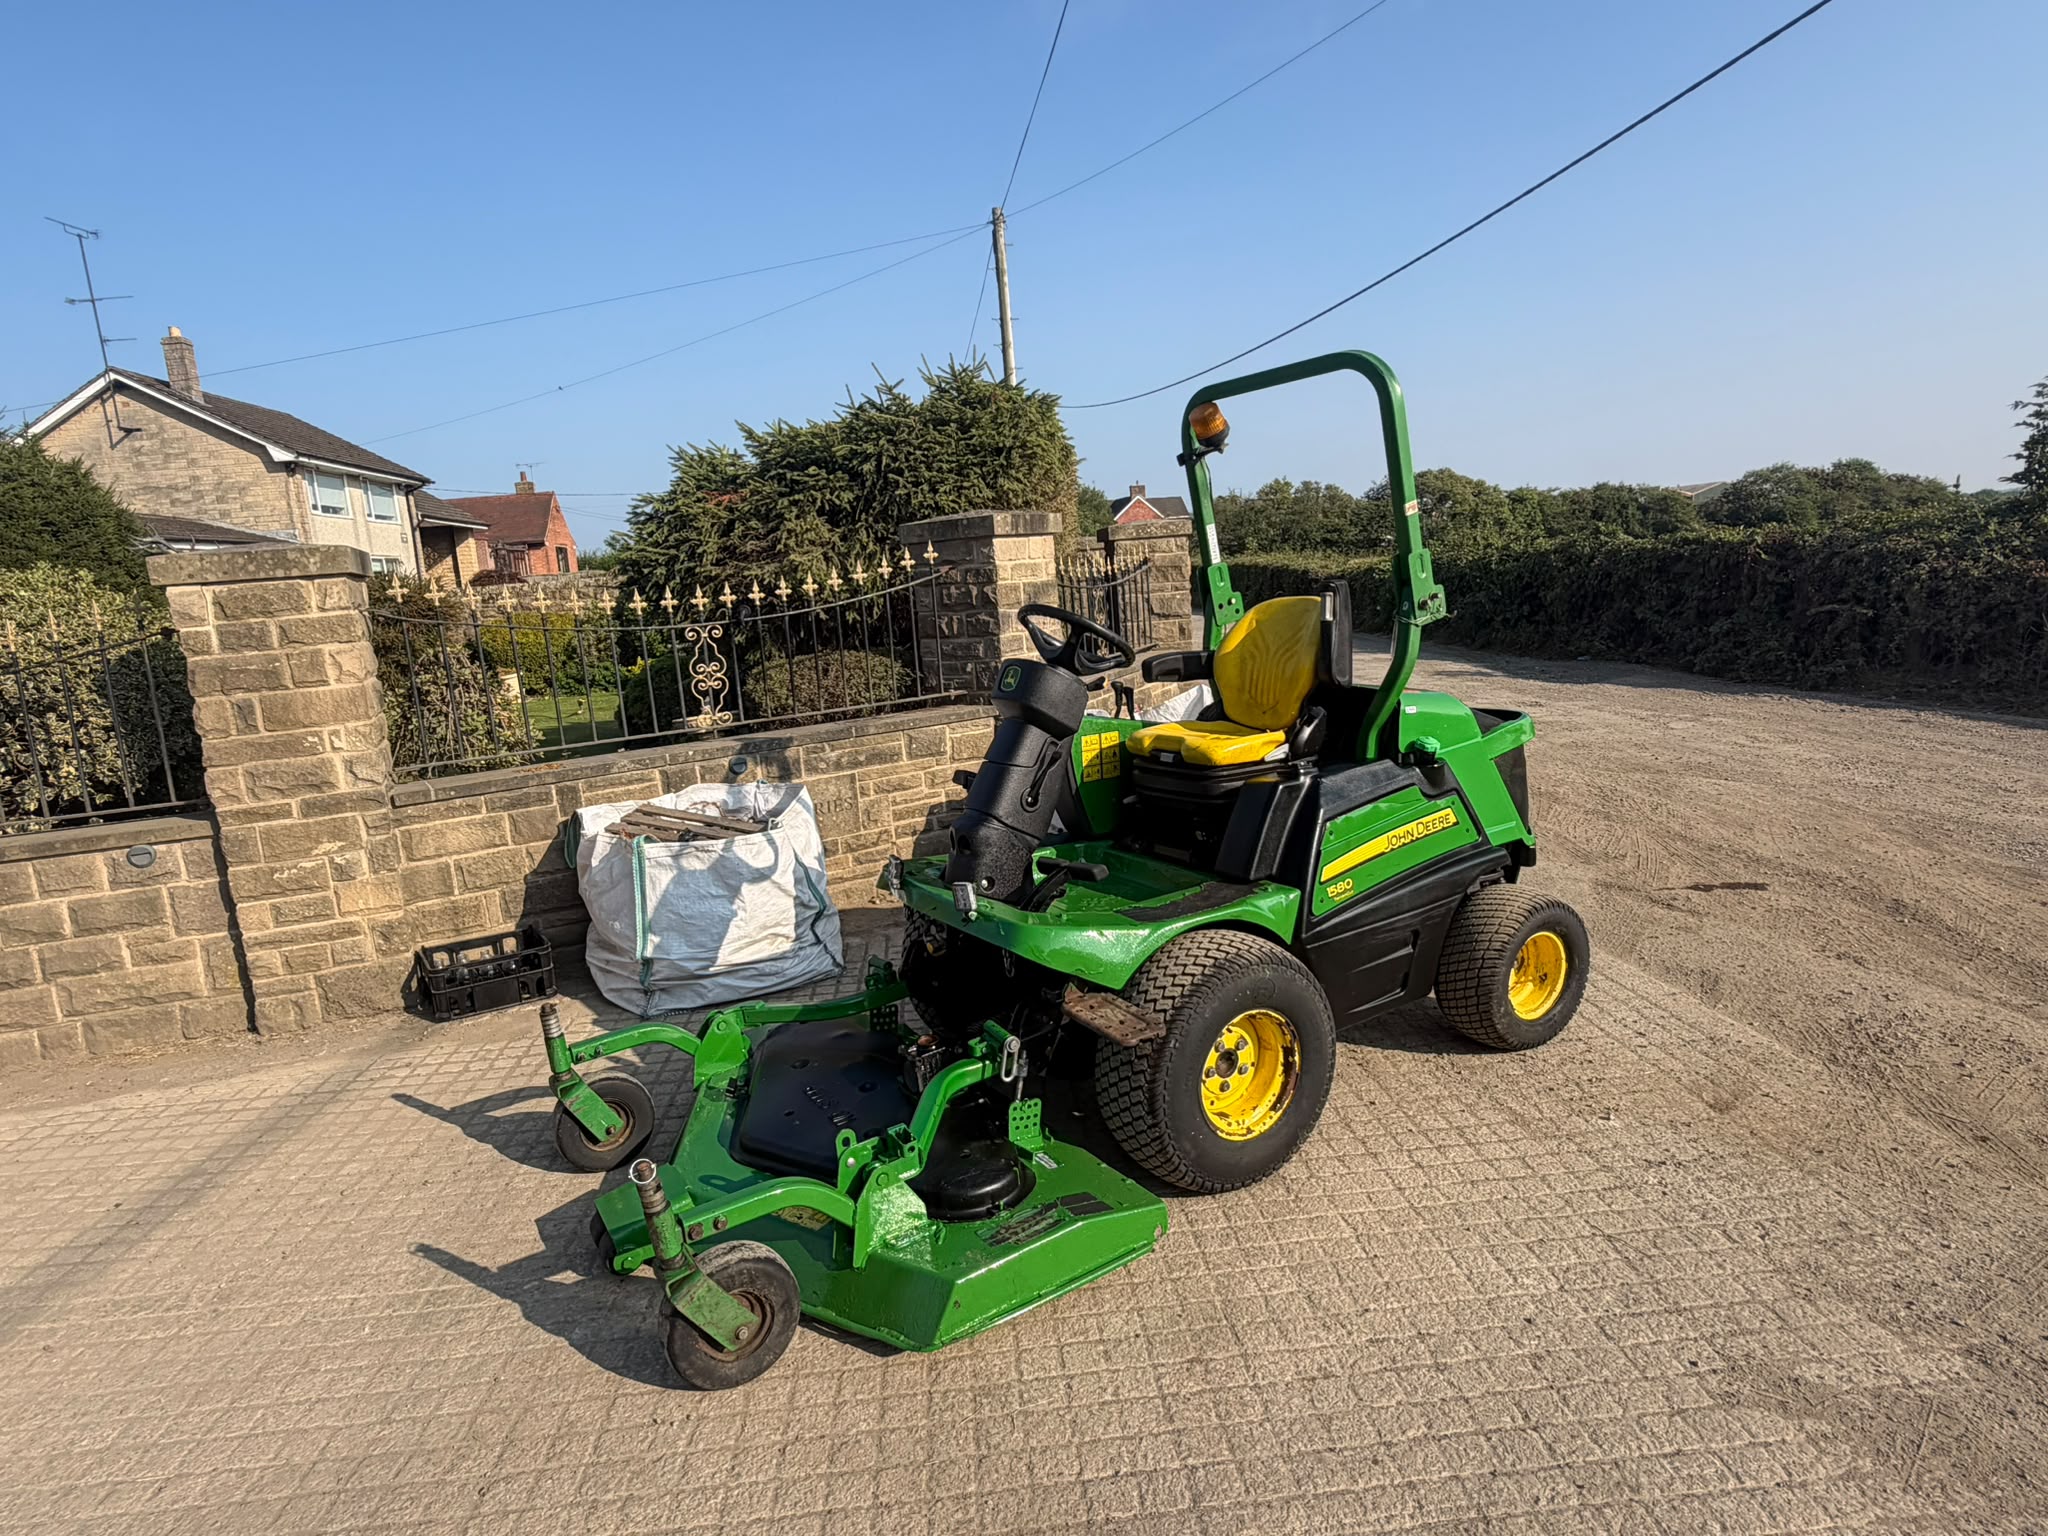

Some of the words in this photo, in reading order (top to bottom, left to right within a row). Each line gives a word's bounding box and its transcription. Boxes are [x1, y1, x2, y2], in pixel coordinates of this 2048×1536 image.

[1384, 827, 1415, 850] JOHN
[1416, 813, 1451, 835] DEERE
[1326, 878, 1353, 897] 1580
